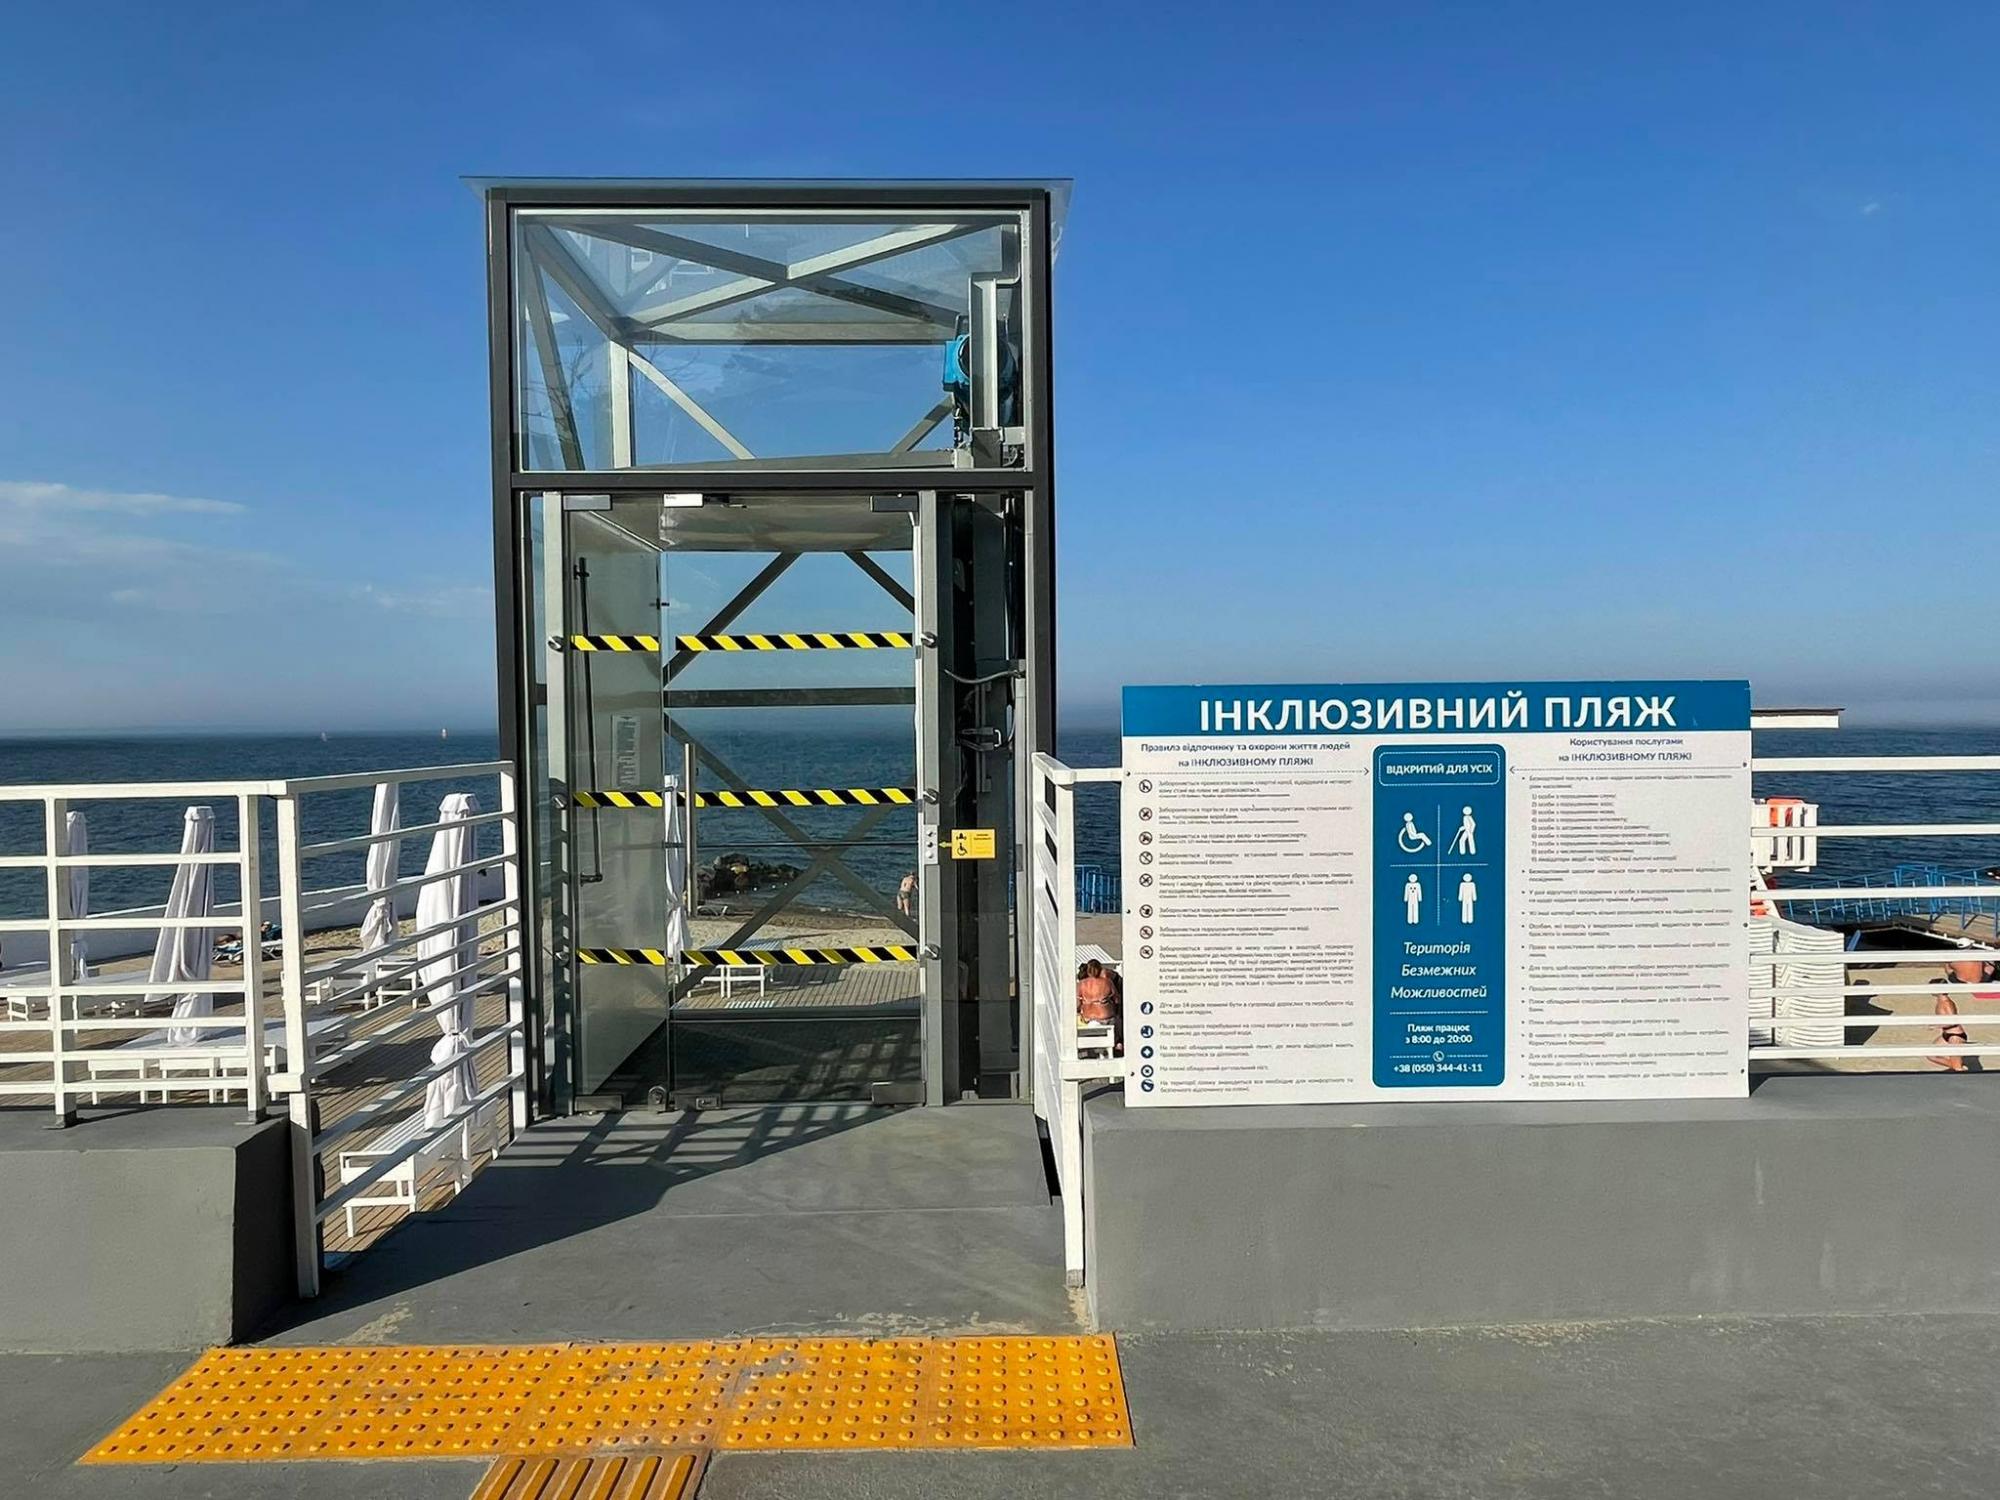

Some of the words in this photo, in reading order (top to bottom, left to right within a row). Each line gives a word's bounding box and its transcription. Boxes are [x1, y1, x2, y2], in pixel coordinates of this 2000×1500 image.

[1201, 691, 1527, 730] ІНКЛЮЗИВНИЙ
[1546, 697, 1676, 727] ПЛЯЖ
[1141, 743, 1180, 753] Правила
[1183, 743, 1234, 753] відпочинку
[1249, 744, 1287, 752] охорони
[1289, 743, 1317, 751] життя
[1320, 741, 1350, 752] людей
[1570, 738, 1633, 748] Користування
[1636, 738, 1683, 747] послугами
[1192, 757, 1276, 767] ІНКЛЮЗИВНОМУ
[1279, 757, 1313, 766] ПЛЯЖІ
[1572, 752, 1656, 762] ІНКЛЮЗИВНОМУ
[1658, 752, 1691, 761] ПЛЯЖІ
[1387, 763, 1444, 776] ВІДКРИТИЙ
[1446, 764, 1468, 775] ДЛЯ
[1470, 764, 1492, 774] УСІХ
[1404, 942, 1470, 956] Територія
[1402, 964, 1476, 976] Безмежних
[1391, 986, 1486, 998] Можливостей
[1408, 1023, 1433, 1033] Пляж
[1436, 1024, 1469, 1034] працює
[1406, 1036, 1410, 1044] з
[1412, 1034, 1431, 1044] 8:00
[1433, 1036, 1445, 1045] до
[1447, 1034, 1472, 1044] 20:00
[1394, 1063, 1410, 1073] +38
[1412, 1063, 1435, 1074] (050)
[1437, 1063, 1482, 1073] 344-41-11
